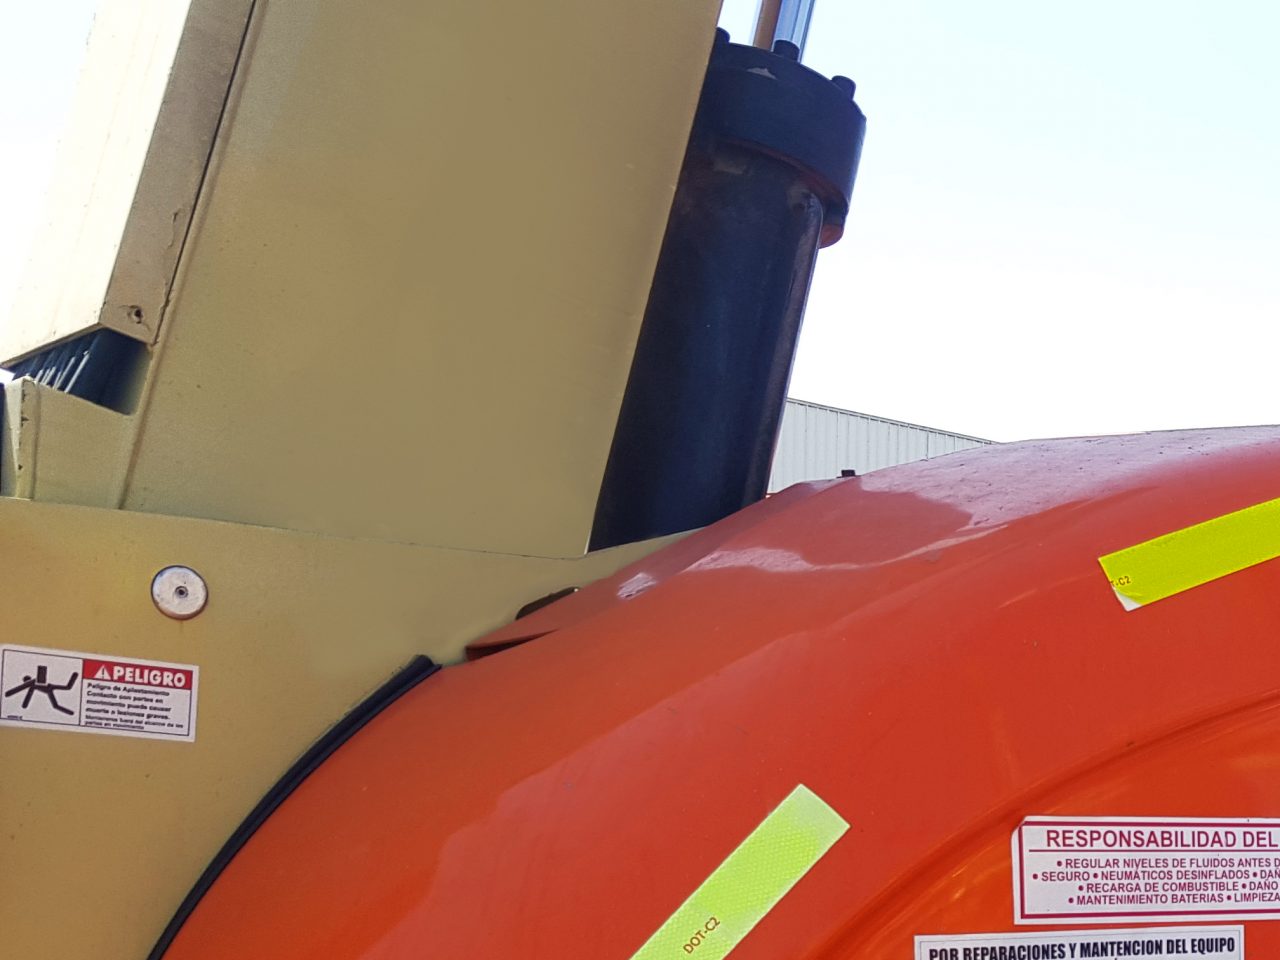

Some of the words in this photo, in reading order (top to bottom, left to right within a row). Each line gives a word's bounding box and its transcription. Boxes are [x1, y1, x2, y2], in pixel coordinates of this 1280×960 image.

[112, 665, 185, 687] PELIGRO
[1046, 829, 1236, 847] RESPONSABILIDAD
[1242, 831, 1278, 847] DEL
[1065, 858, 1119, 868] REGULAR
[1123, 858, 1168, 868] NIVELES
[1172, 858, 1186, 867] DE
[1190, 858, 1234, 868] FLUIDOS
[1237, 858, 1270, 867] ANTES
[1041, 871, 1090, 881] SEGURO
[1176, 870, 1250, 880] DESINFLADOS
[1086, 882, 1141, 893] RECARGA
[1144, 882, 1159, 892] DE
[1162, 881, 1239, 891] COMBUSTIBLE
[1249, 879, 1278, 890] DAÑO
[1076, 894, 1168, 905] MANTENIMIENTO
[1171, 893, 1224, 903] BATERIAS
[1234, 892, 1280, 903] LIMPIEZA
[683, 917, 720, 954] DOT-C2
[1069, 942, 1077, 958] Y
[1079, 940, 1163, 958] MANTENCION
[1166, 938, 1188, 954] DEL
[1191, 937, 1235, 955] EQUIPO
